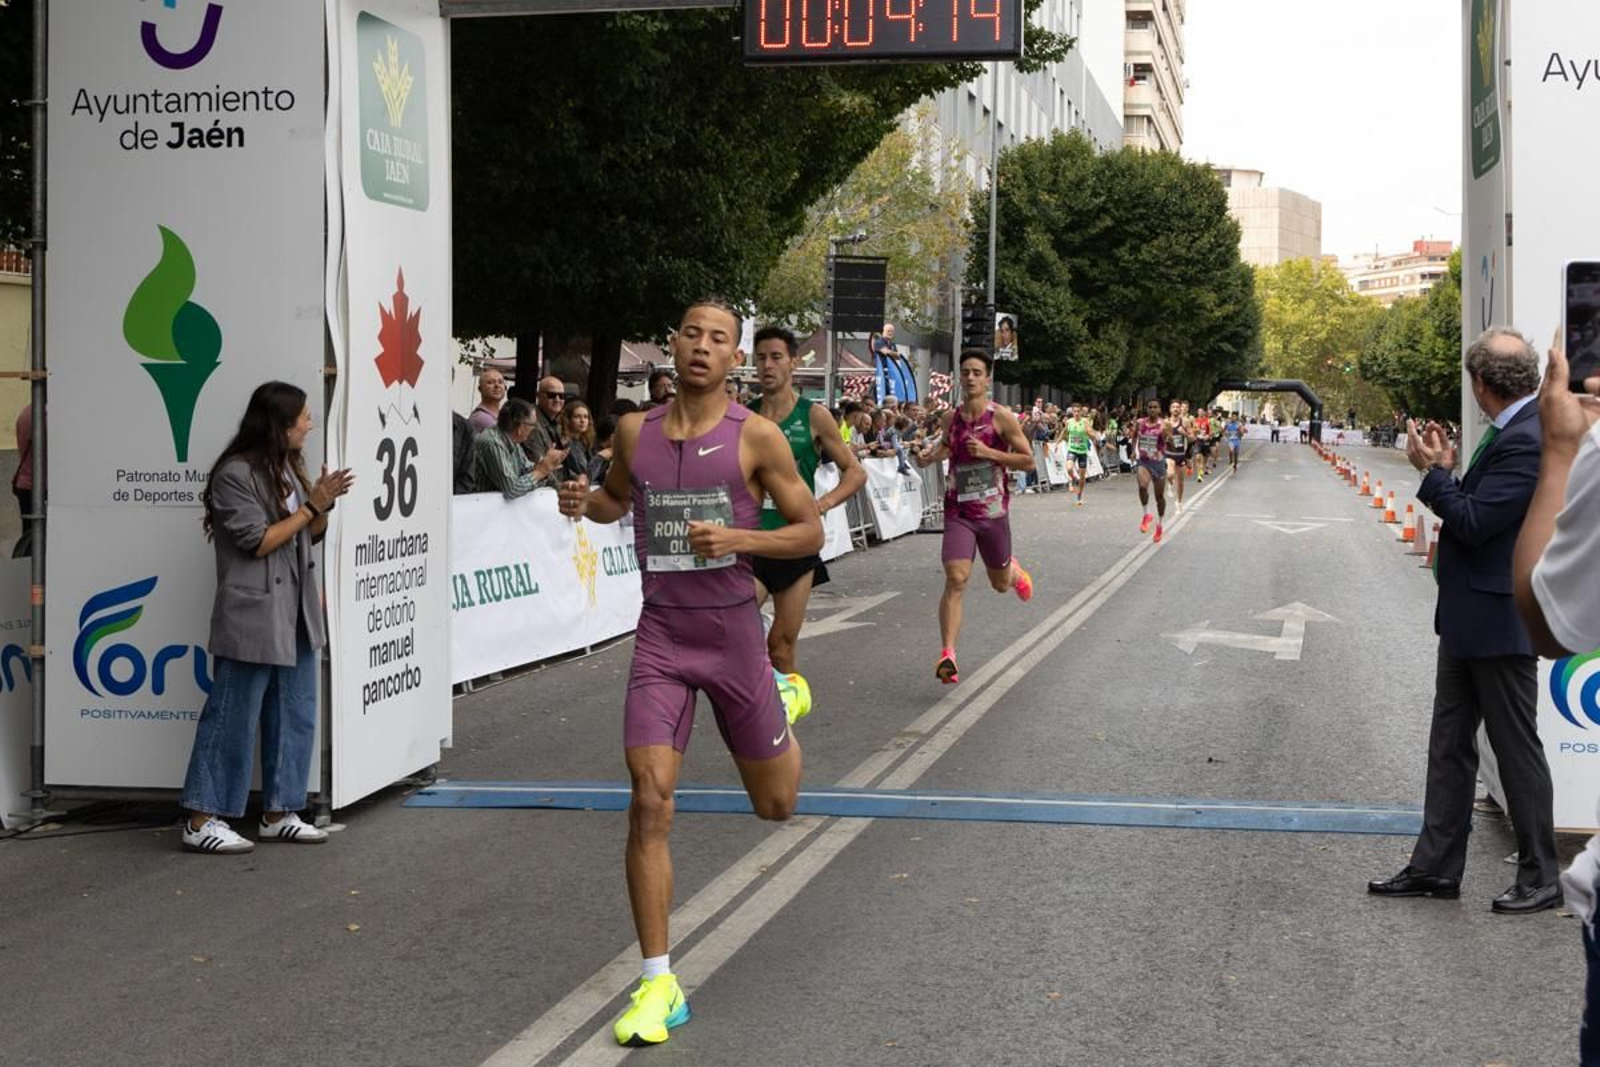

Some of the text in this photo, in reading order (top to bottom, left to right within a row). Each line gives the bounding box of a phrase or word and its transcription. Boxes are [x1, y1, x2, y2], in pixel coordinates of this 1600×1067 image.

[71, 85, 295, 123] Ayuntamiento
[119, 120, 245, 150] de Jaén
[366, 128, 392, 155] CAJA
[116, 469, 181, 482] Patronato
[373, 436, 419, 522] 36
[112, 488, 130, 502] de
[133, 488, 194, 505] Deportes
[355, 530, 429, 567] milla urbana
[355, 558, 427, 602] internacional
[452, 562, 539, 612] JA RURAL
[367, 595, 416, 634] de otoño
[369, 626, 414, 669] manuel
[362, 662, 421, 716] pancorbo
[80, 708, 199, 721] POSITIVAMENTE
